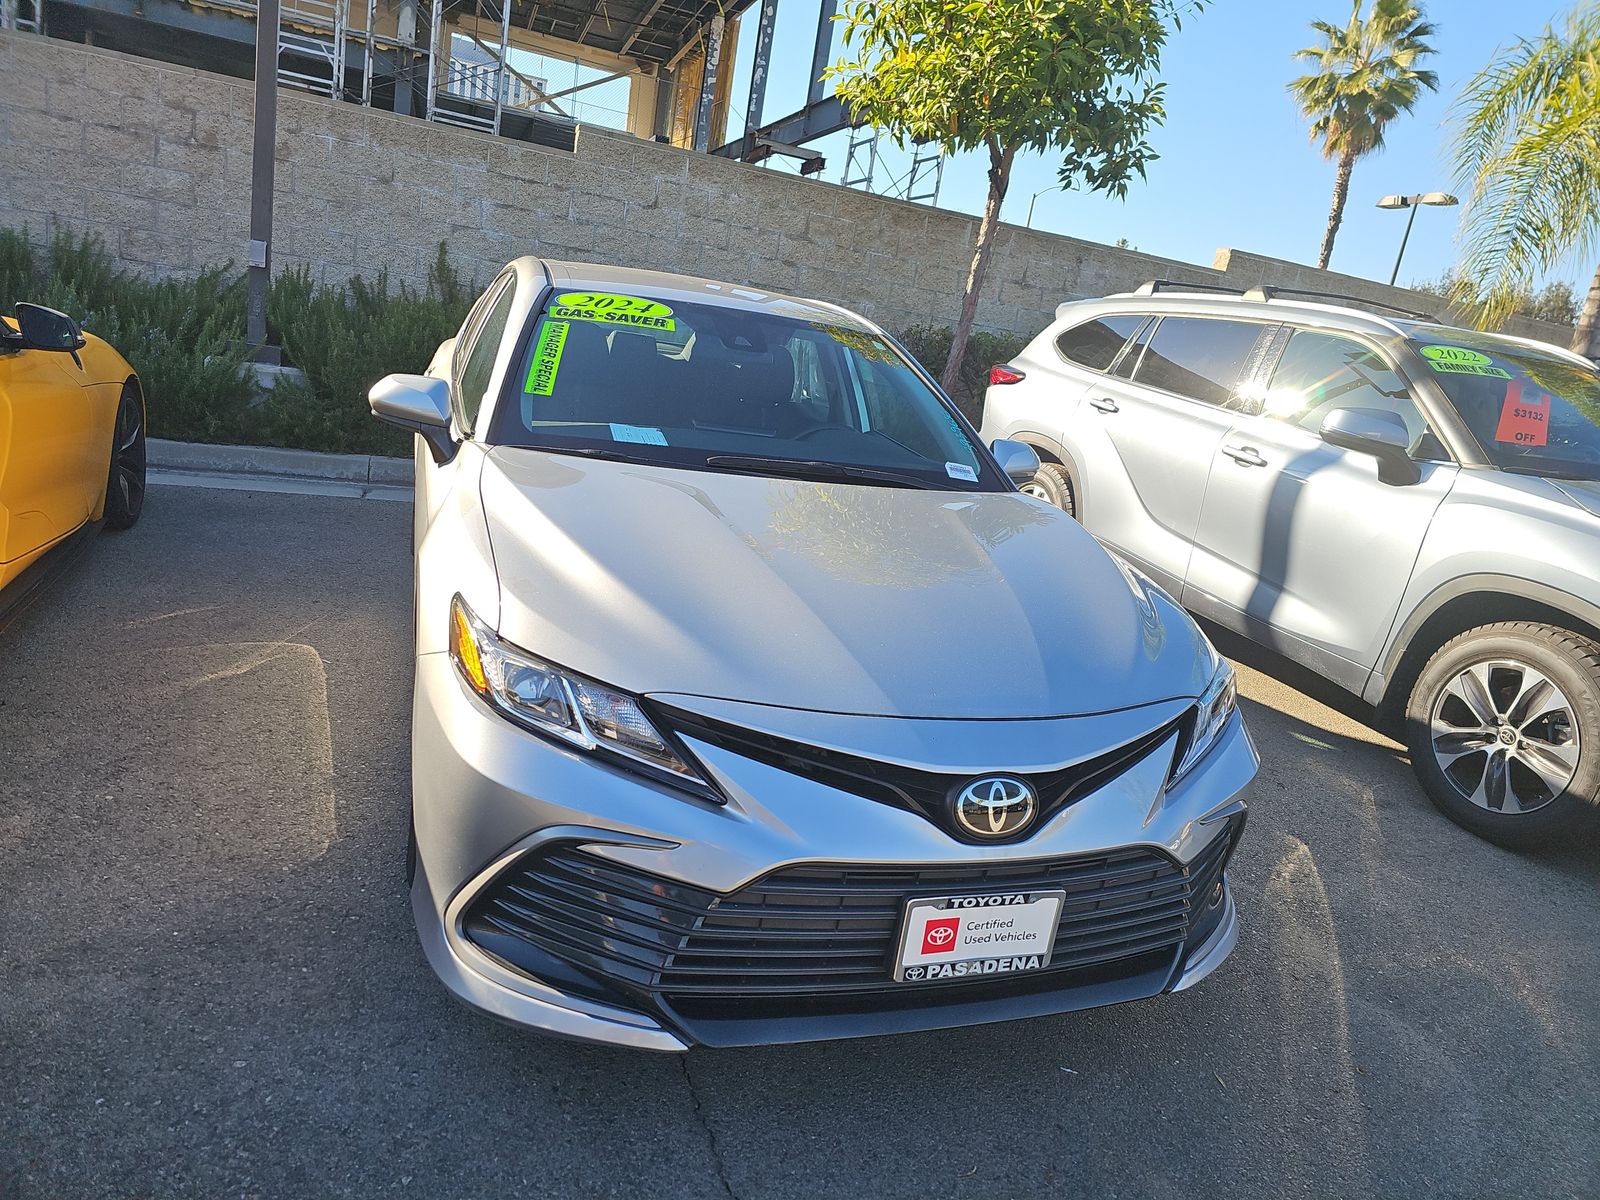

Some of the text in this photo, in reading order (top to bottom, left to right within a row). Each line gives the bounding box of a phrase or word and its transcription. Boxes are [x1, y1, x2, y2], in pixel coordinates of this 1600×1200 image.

[574, 295, 655, 314] 2024
[556, 307, 668, 328] GAS-SAVER
[533, 322, 565, 393] MANAGER SPECIAL
[1434, 348, 1481, 362] 2022
[1436, 361, 1505, 377] FAMILY SIZE
[1513, 408, 1544, 422] $3132
[1515, 432, 1536, 443] OFF
[951, 894, 1026, 909] TOYOTA
[966, 918, 1014, 931] Certified
[964, 931, 1037, 945] Used Vehicles
[926, 956, 1040, 979] PASADENA
